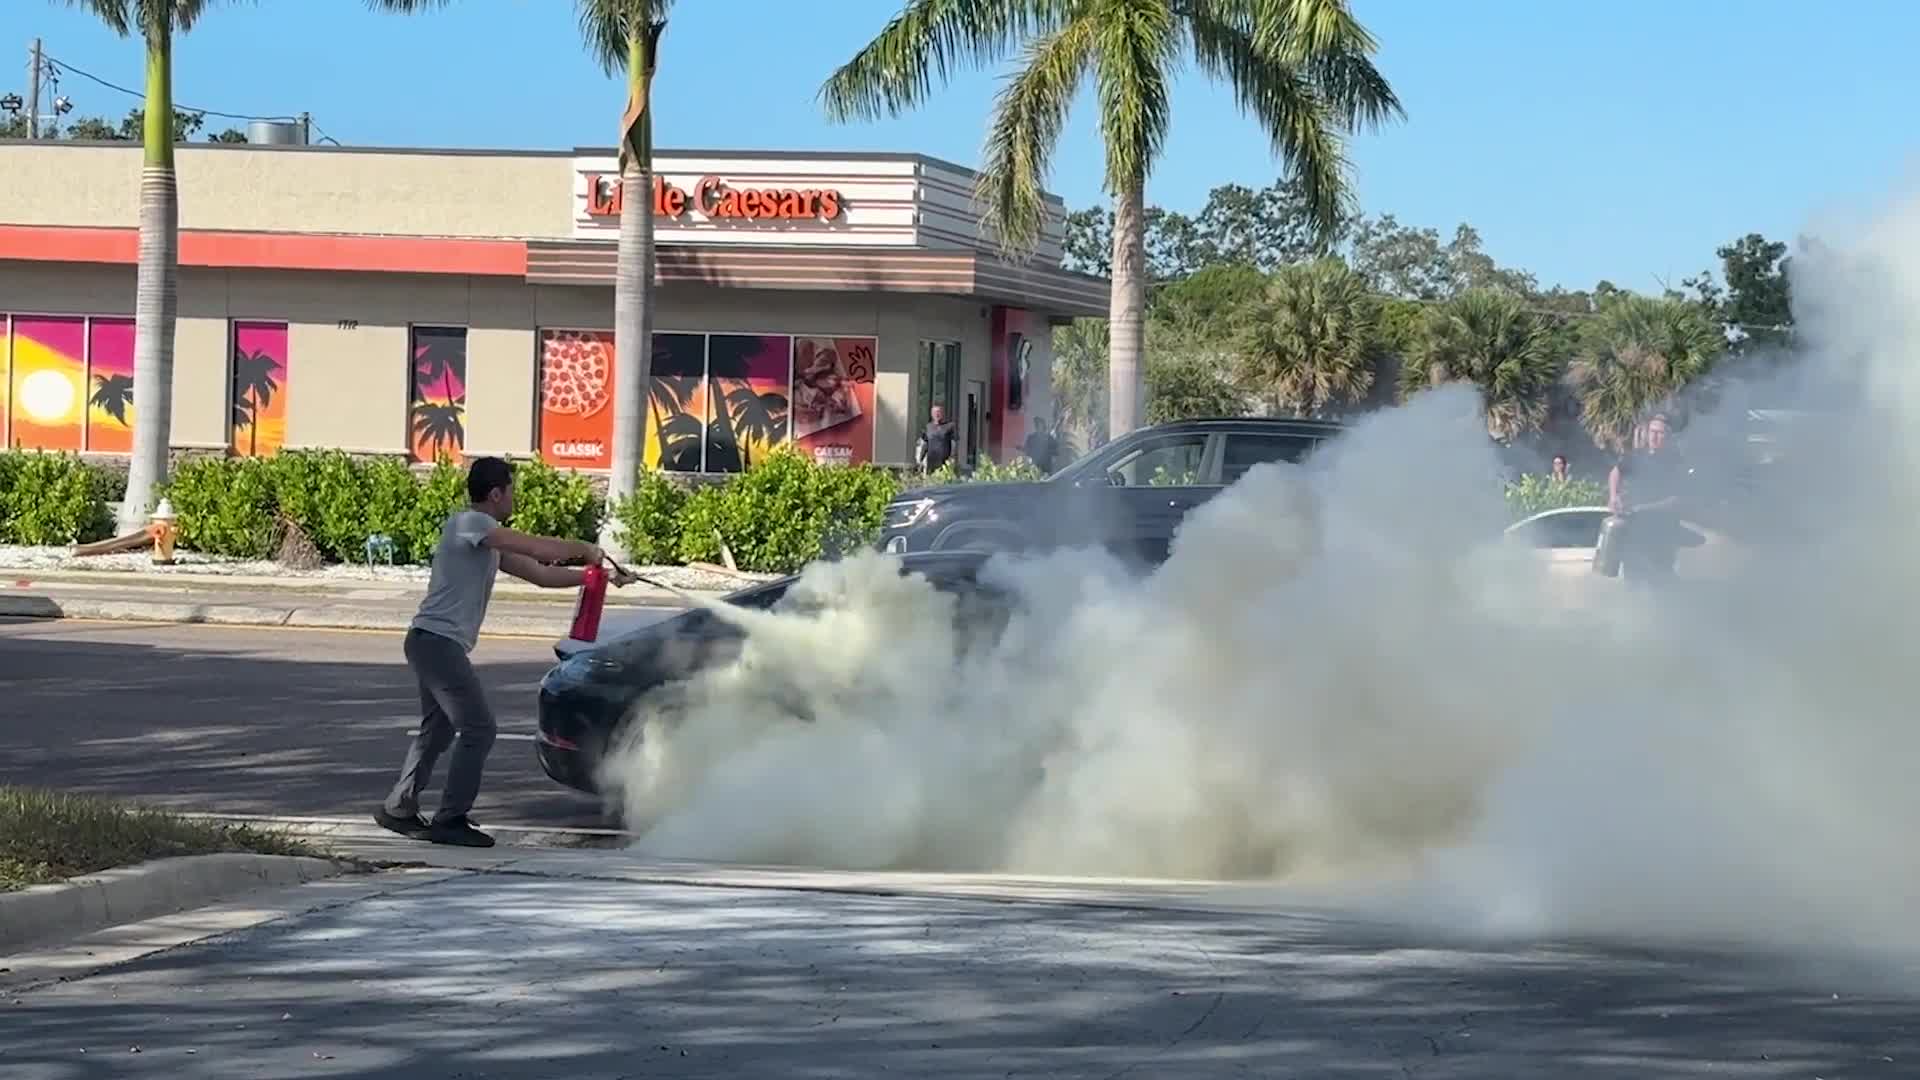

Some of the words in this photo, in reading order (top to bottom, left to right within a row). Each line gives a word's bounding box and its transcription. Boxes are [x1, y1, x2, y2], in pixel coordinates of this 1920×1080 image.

[585, 173, 686, 217] Lile
[694, 175, 840, 220] Caesars
[552, 443, 604, 457] CLASSIC
